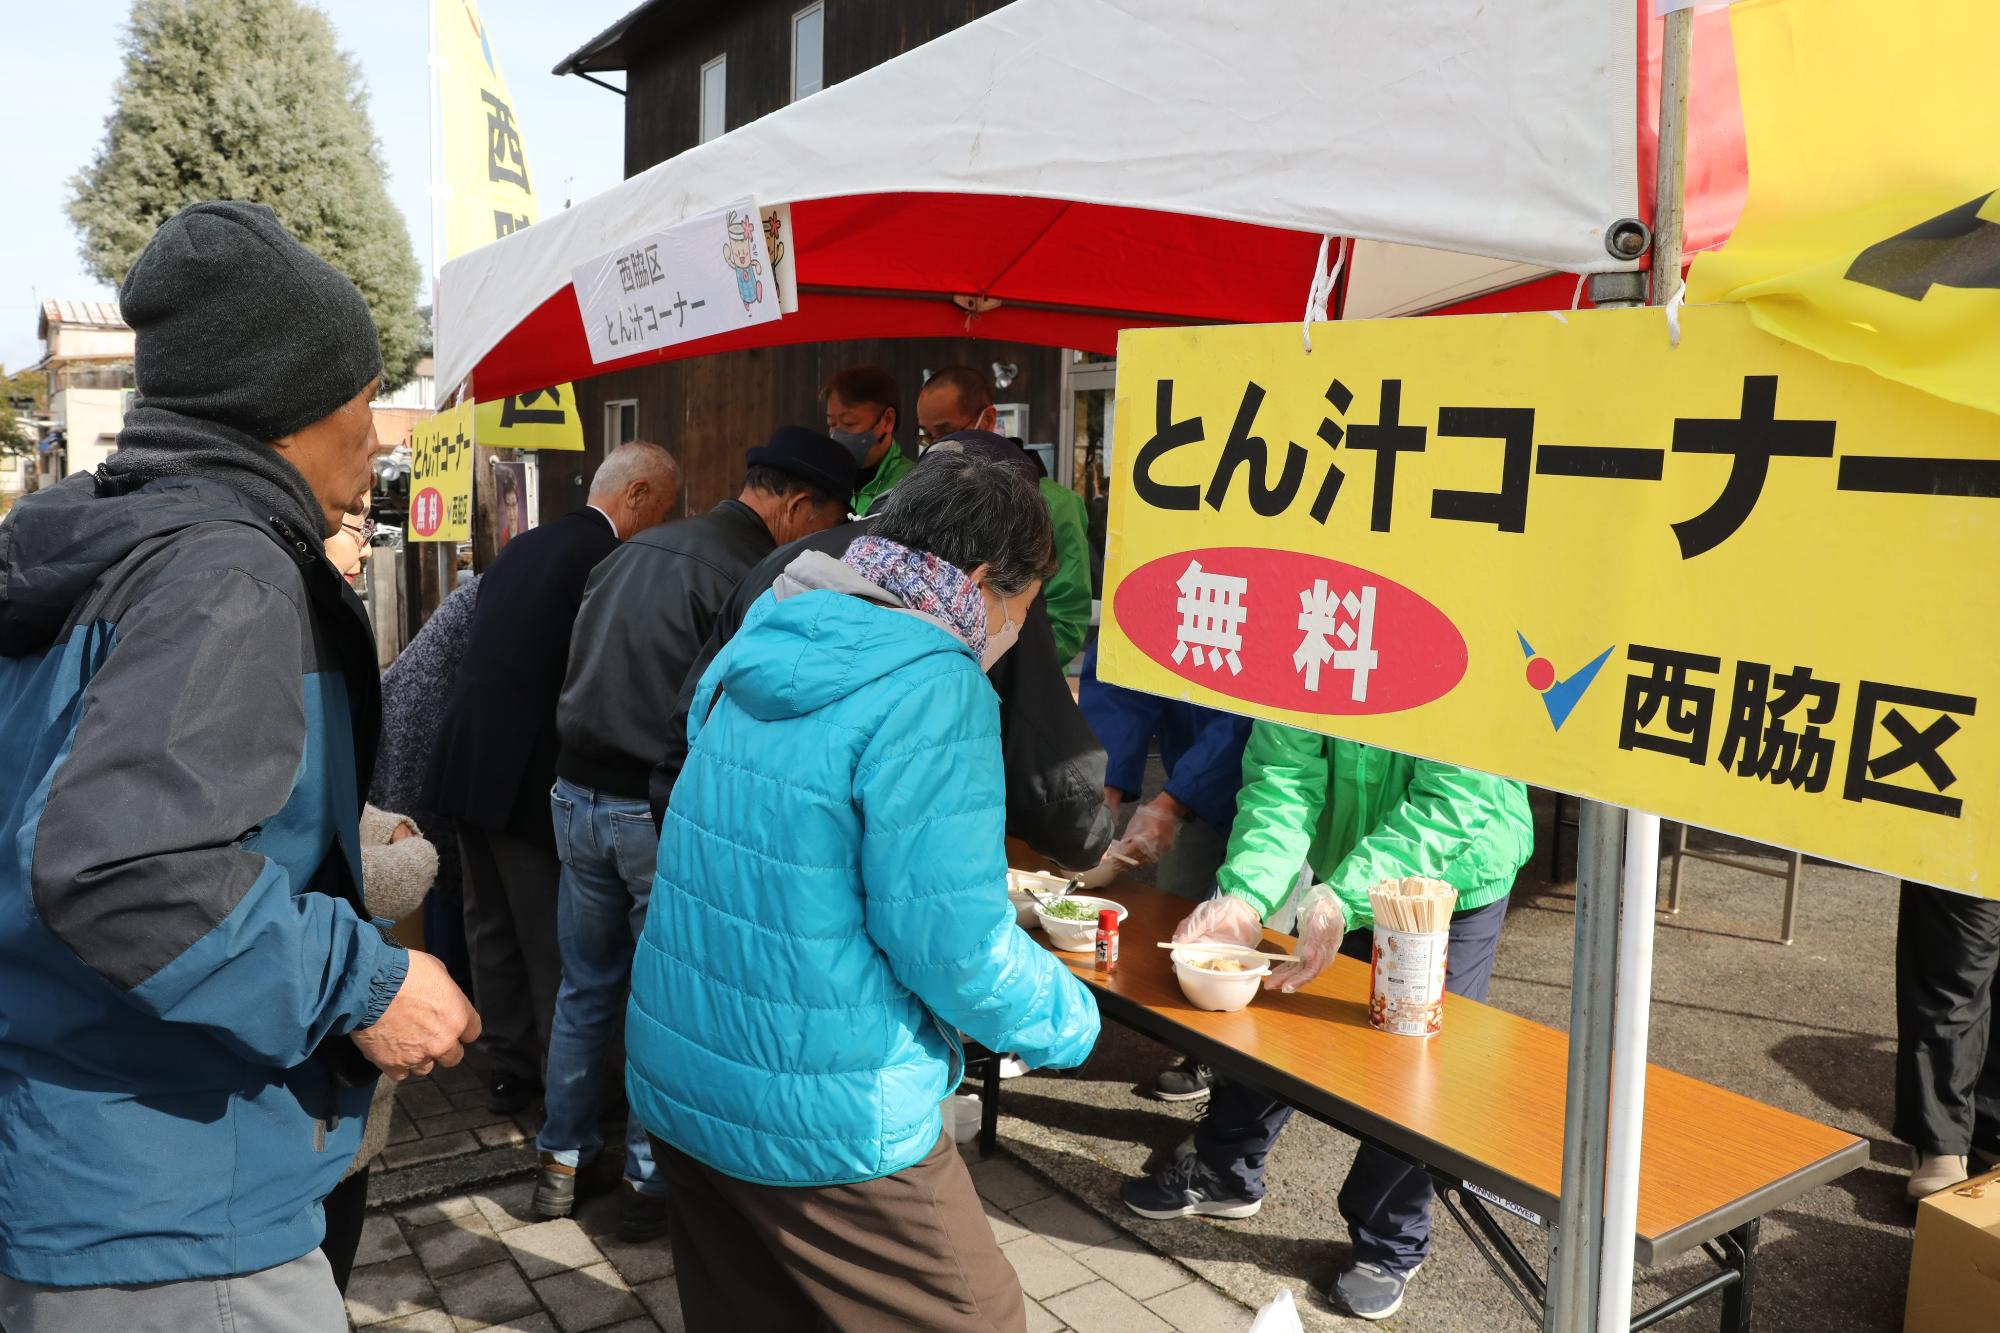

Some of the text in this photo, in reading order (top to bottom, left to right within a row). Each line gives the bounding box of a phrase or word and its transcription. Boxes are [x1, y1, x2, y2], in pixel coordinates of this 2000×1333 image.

[616, 243, 665, 294] 西脇区
[606, 291, 706, 346] とん汁コーナー
[413, 423, 471, 480] とん汁コーナー
[1132, 375, 2000, 559] とん汁コーナー
[416, 493, 438, 530] 無料
[1171, 560, 1379, 703] 無料
[1619, 644, 1977, 818] 西脇区
[1505, 1201, 1536, 1221] POWER
